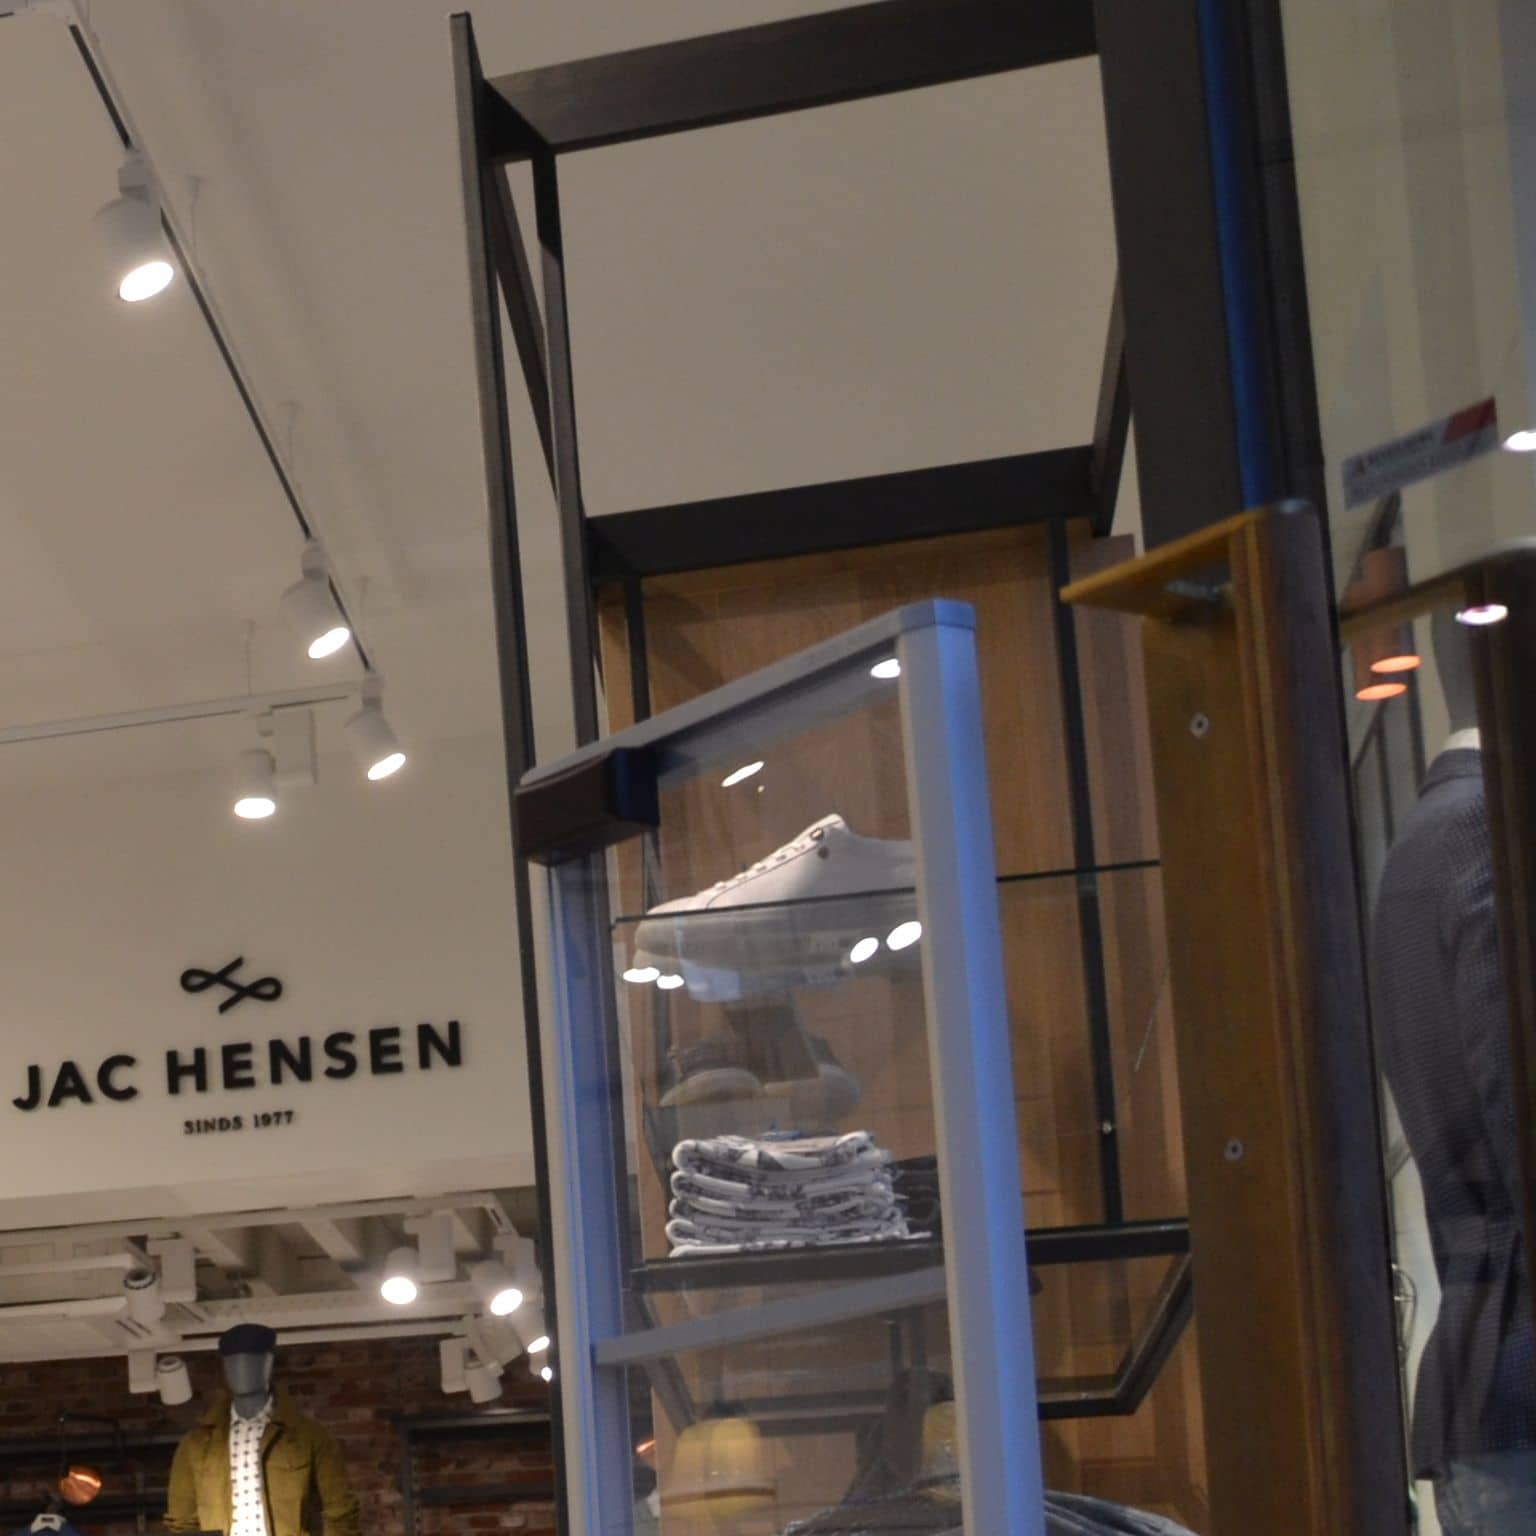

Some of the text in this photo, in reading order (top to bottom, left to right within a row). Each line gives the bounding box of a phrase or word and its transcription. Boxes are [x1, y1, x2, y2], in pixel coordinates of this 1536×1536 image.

[12, 1020, 463, 1111] JAC HENSEN
[184, 1110, 295, 1135] SINDS 1977
